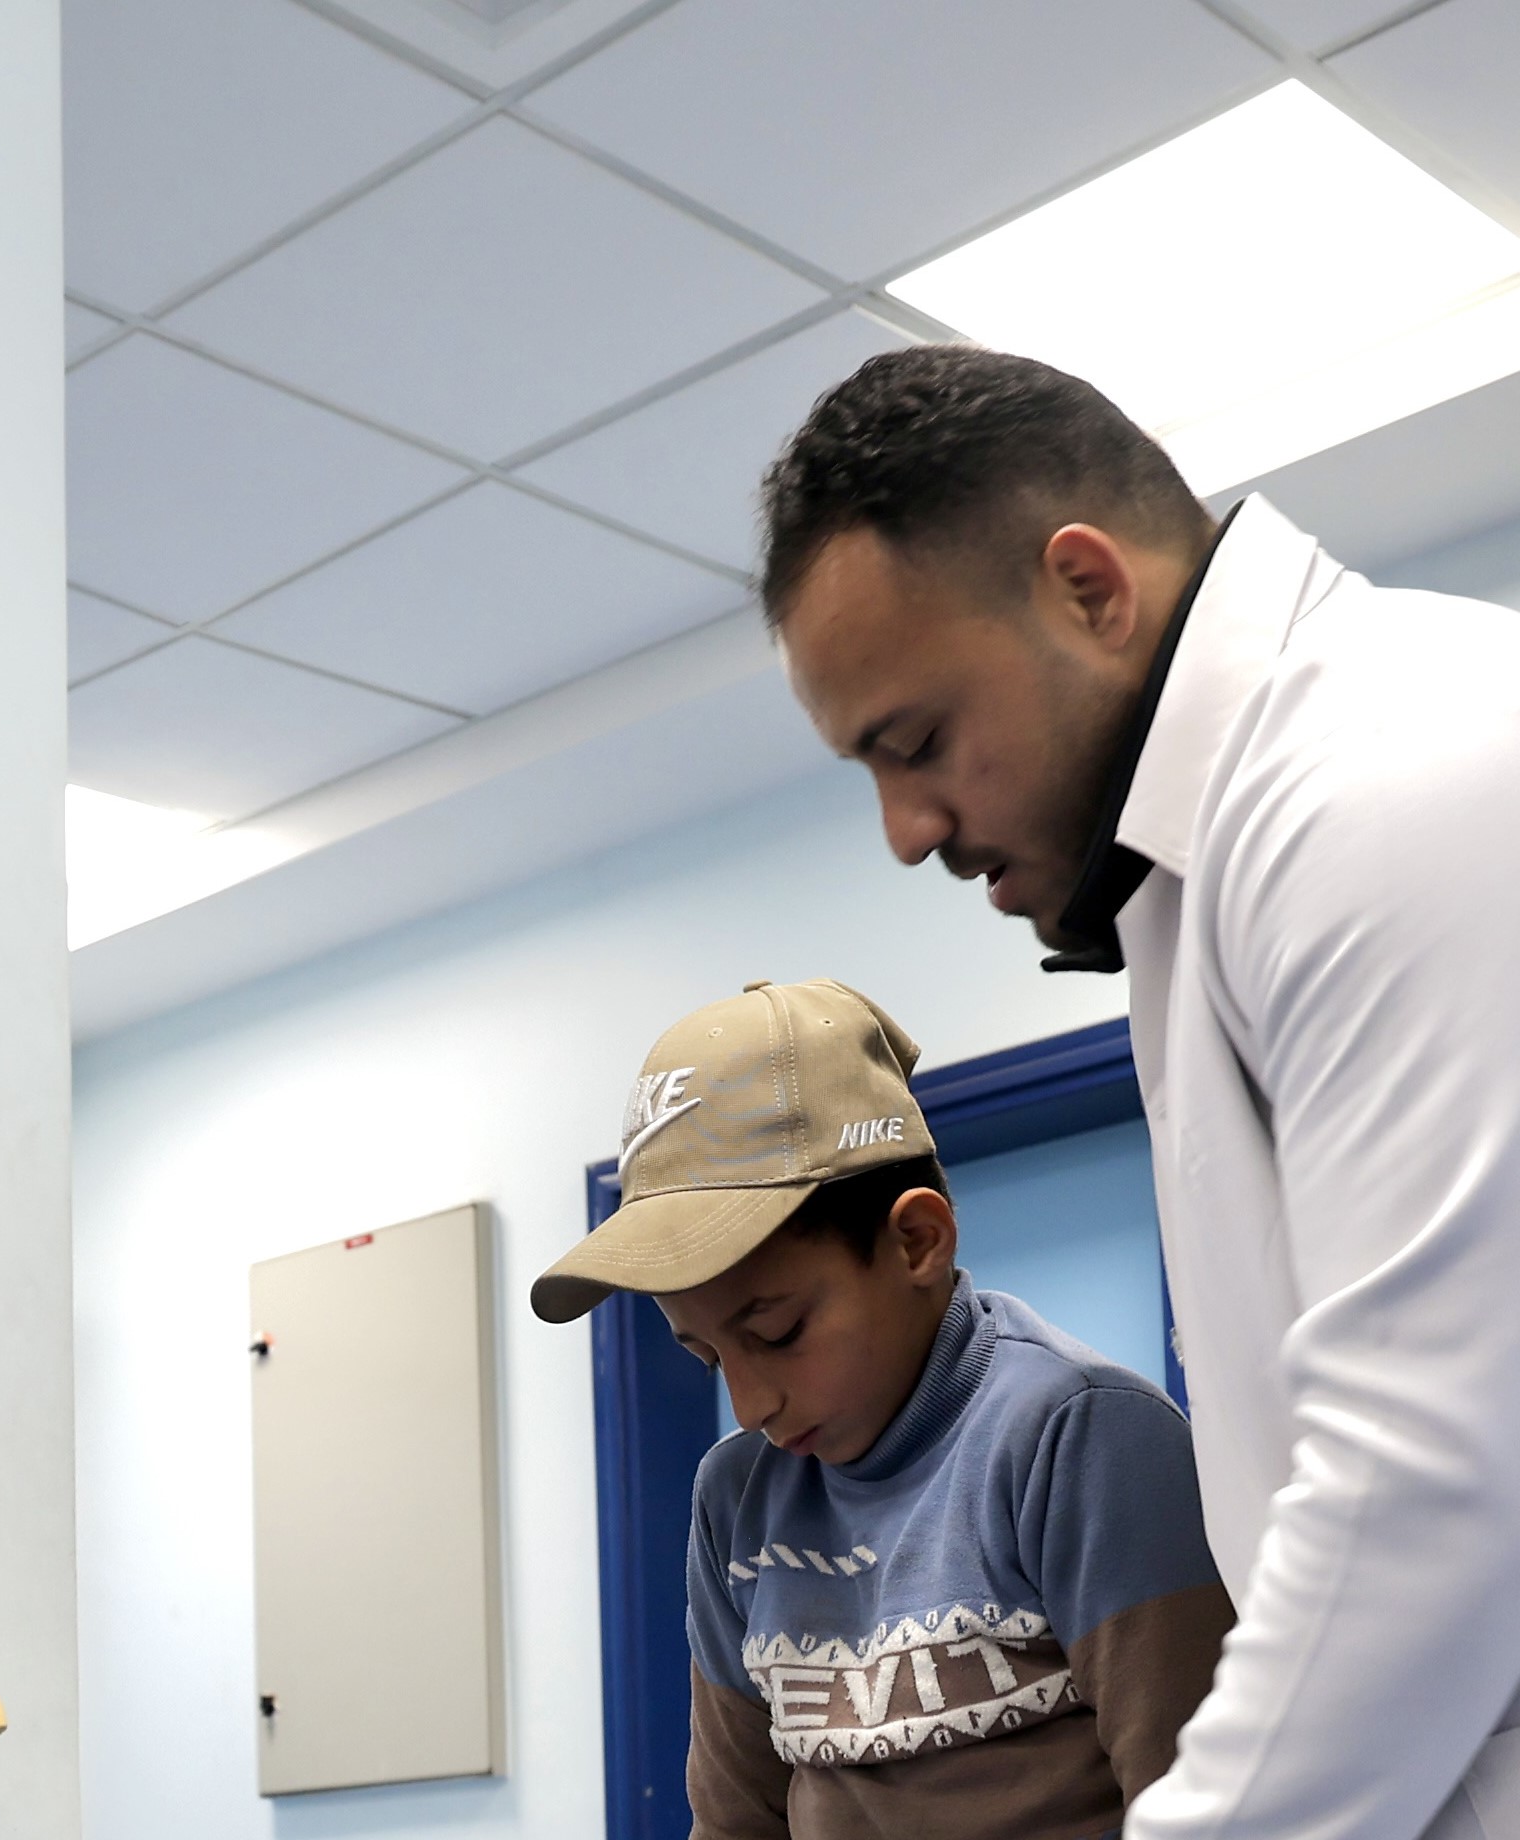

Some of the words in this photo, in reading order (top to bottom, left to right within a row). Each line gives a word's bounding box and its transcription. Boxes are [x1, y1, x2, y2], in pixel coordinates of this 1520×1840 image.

[628, 1066, 697, 1134] KE
[837, 1116, 905, 1151] NIKE
[755, 1636, 1027, 1728] EVIT
